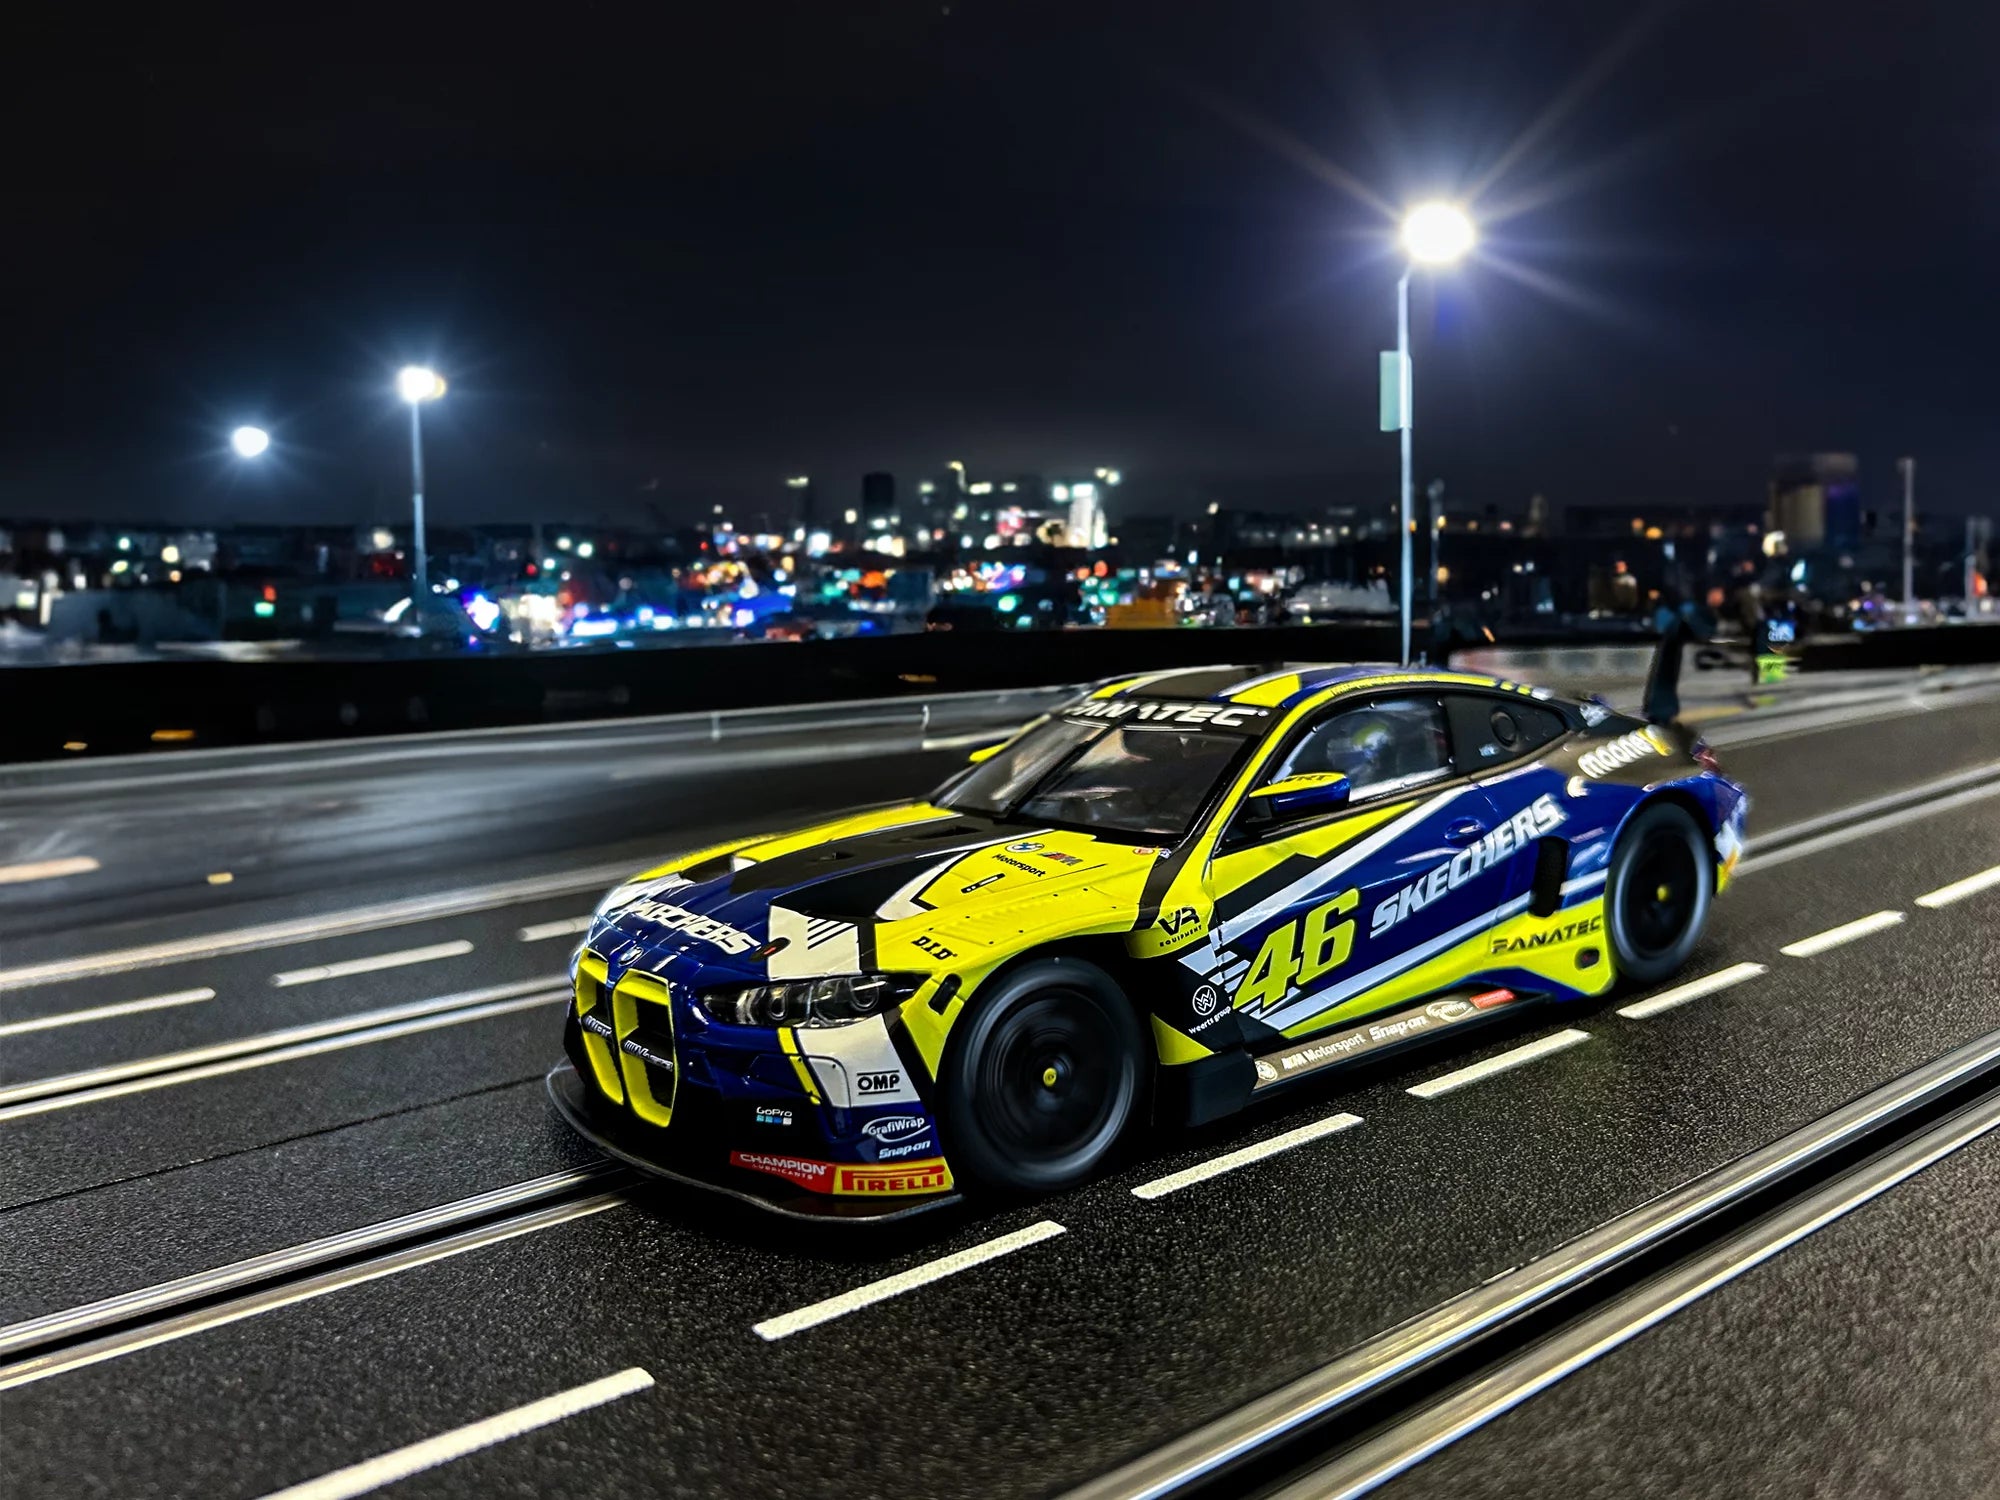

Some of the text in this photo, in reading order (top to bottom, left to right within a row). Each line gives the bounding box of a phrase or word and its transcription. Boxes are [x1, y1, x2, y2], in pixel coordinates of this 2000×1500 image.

[992, 854, 1046, 877] Motorsport
[1369, 793, 1569, 939] SKECHERS
[1160, 925, 1202, 947] EQUIPMENT
[1491, 915, 1602, 954] FANATEC
[911, 936, 954, 960] D.I.D
[1233, 888, 1359, 1009] 46
[1189, 1006, 1232, 1035] weerts group
[1303, 1033, 1367, 1063] Motorsport
[1368, 1015, 1429, 1042] Snap-on
[857, 1074, 900, 1091] OMP
[756, 1106, 793, 1117] GoPro
[867, 1116, 925, 1136] GrafiWrap
[879, 1140, 931, 1160] Snap-on
[739, 1153, 827, 1176] CHAMPION
[841, 1165, 946, 1192] PIRELLI
